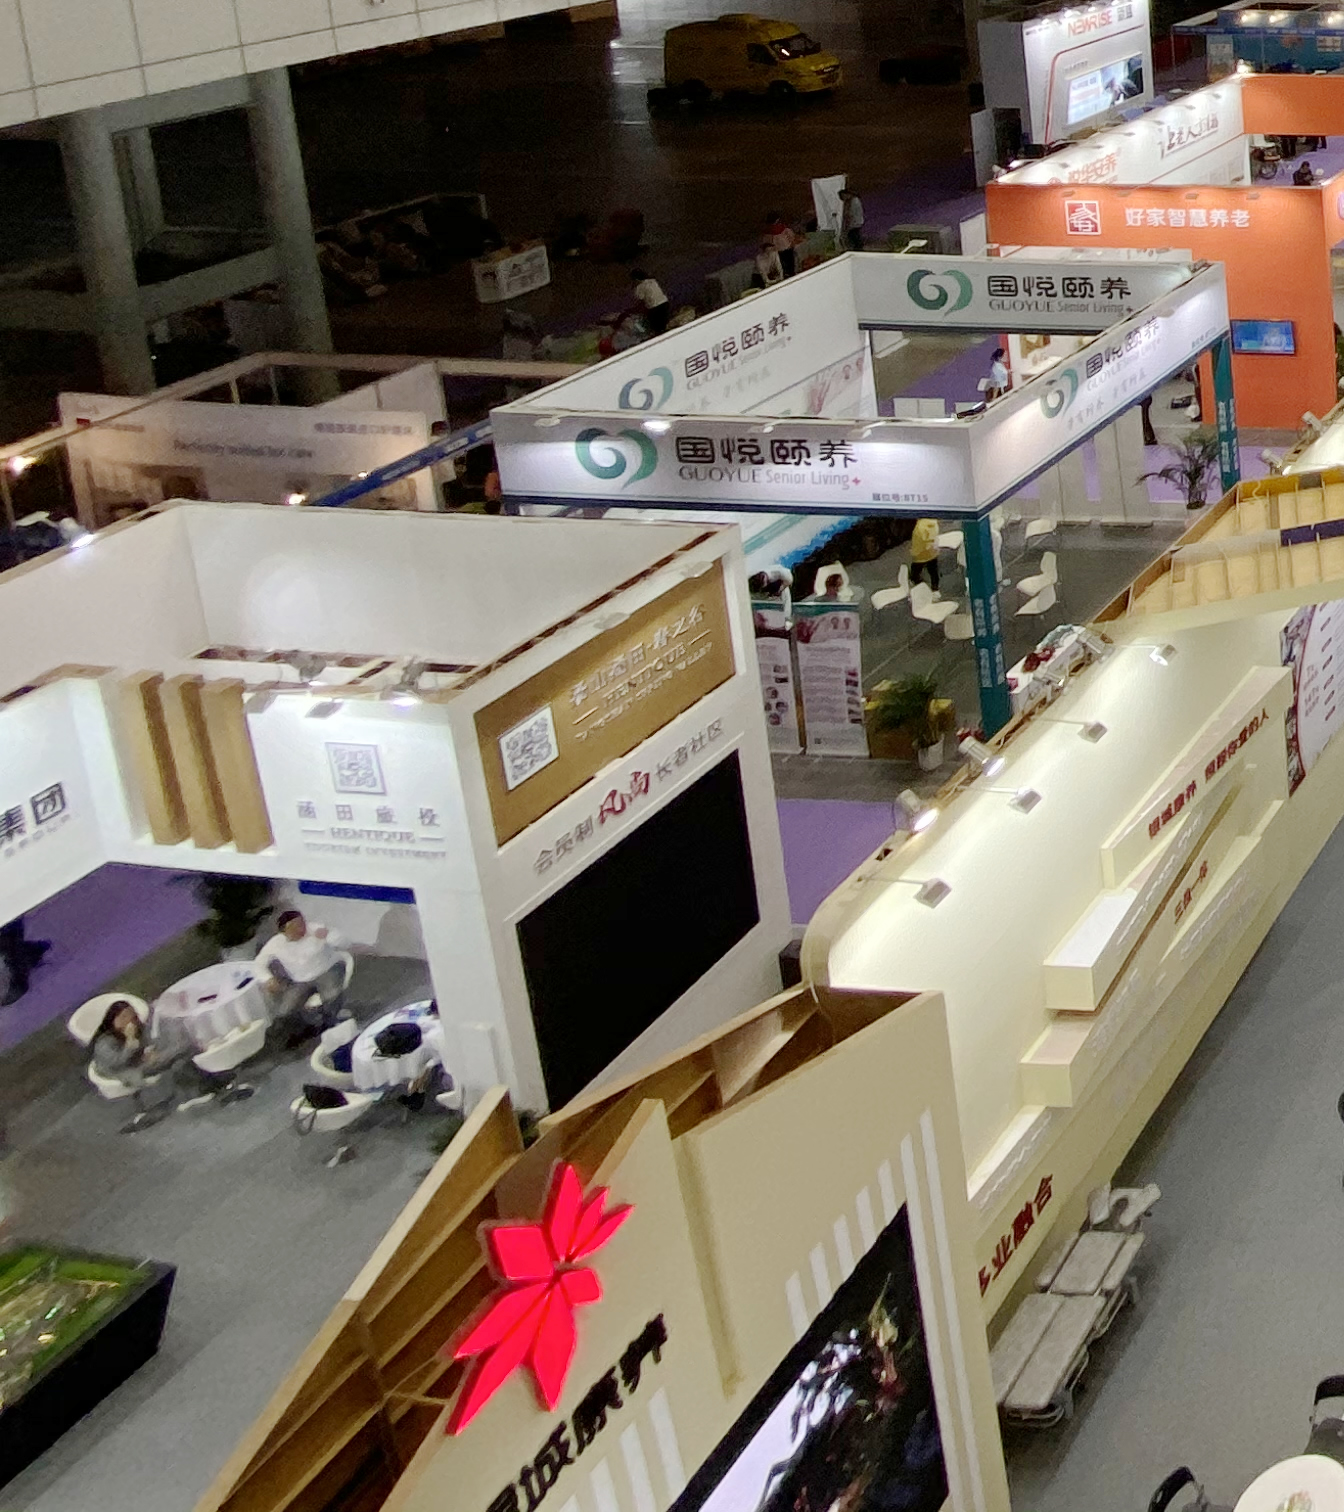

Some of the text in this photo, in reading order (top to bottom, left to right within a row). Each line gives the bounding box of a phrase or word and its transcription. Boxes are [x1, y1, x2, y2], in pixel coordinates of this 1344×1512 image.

[1124, 206, 1251, 229] 好家智慧养老
[987, 274, 1133, 301] 国悦颐养
[684, 311, 792, 379] 国悦颐养
[674, 434, 860, 470] 国悦颐养
[678, 465, 851, 491] GUOYUE Senior Living
